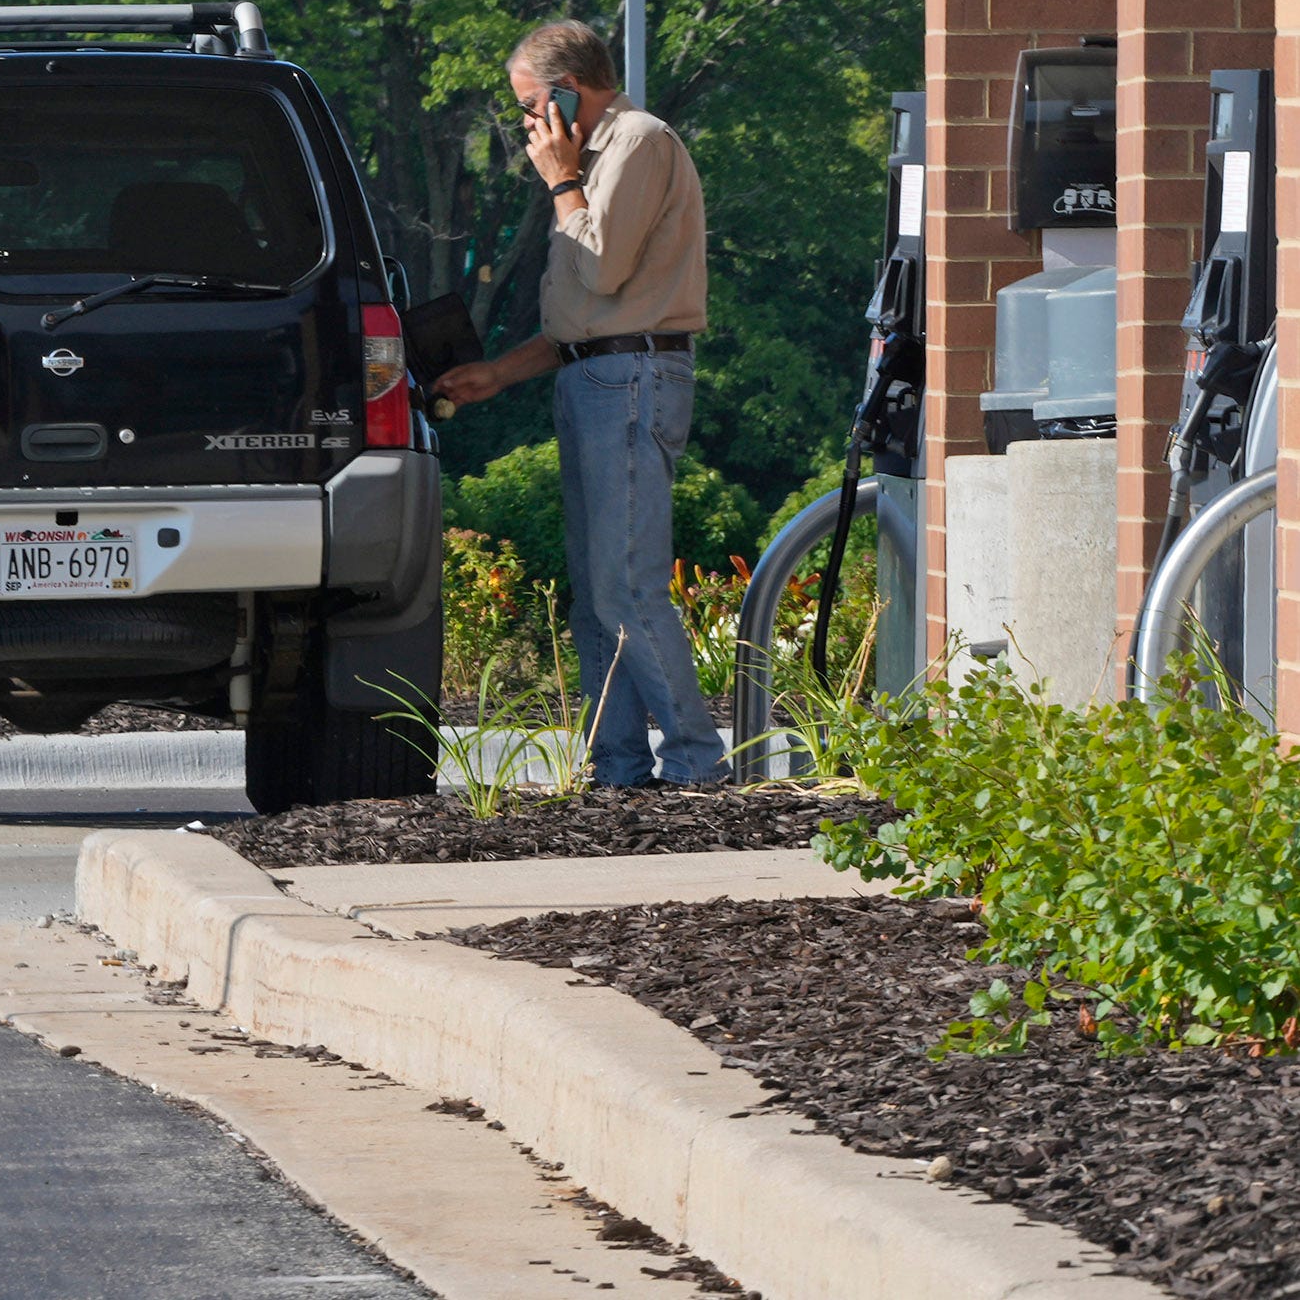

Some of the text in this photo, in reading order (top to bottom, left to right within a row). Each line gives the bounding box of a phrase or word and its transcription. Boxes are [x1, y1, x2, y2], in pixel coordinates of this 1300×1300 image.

[5, 531, 75, 542] WISCONSIN
[8, 547, 129, 579] ANB-6979
[5, 582, 22, 591] SEP
